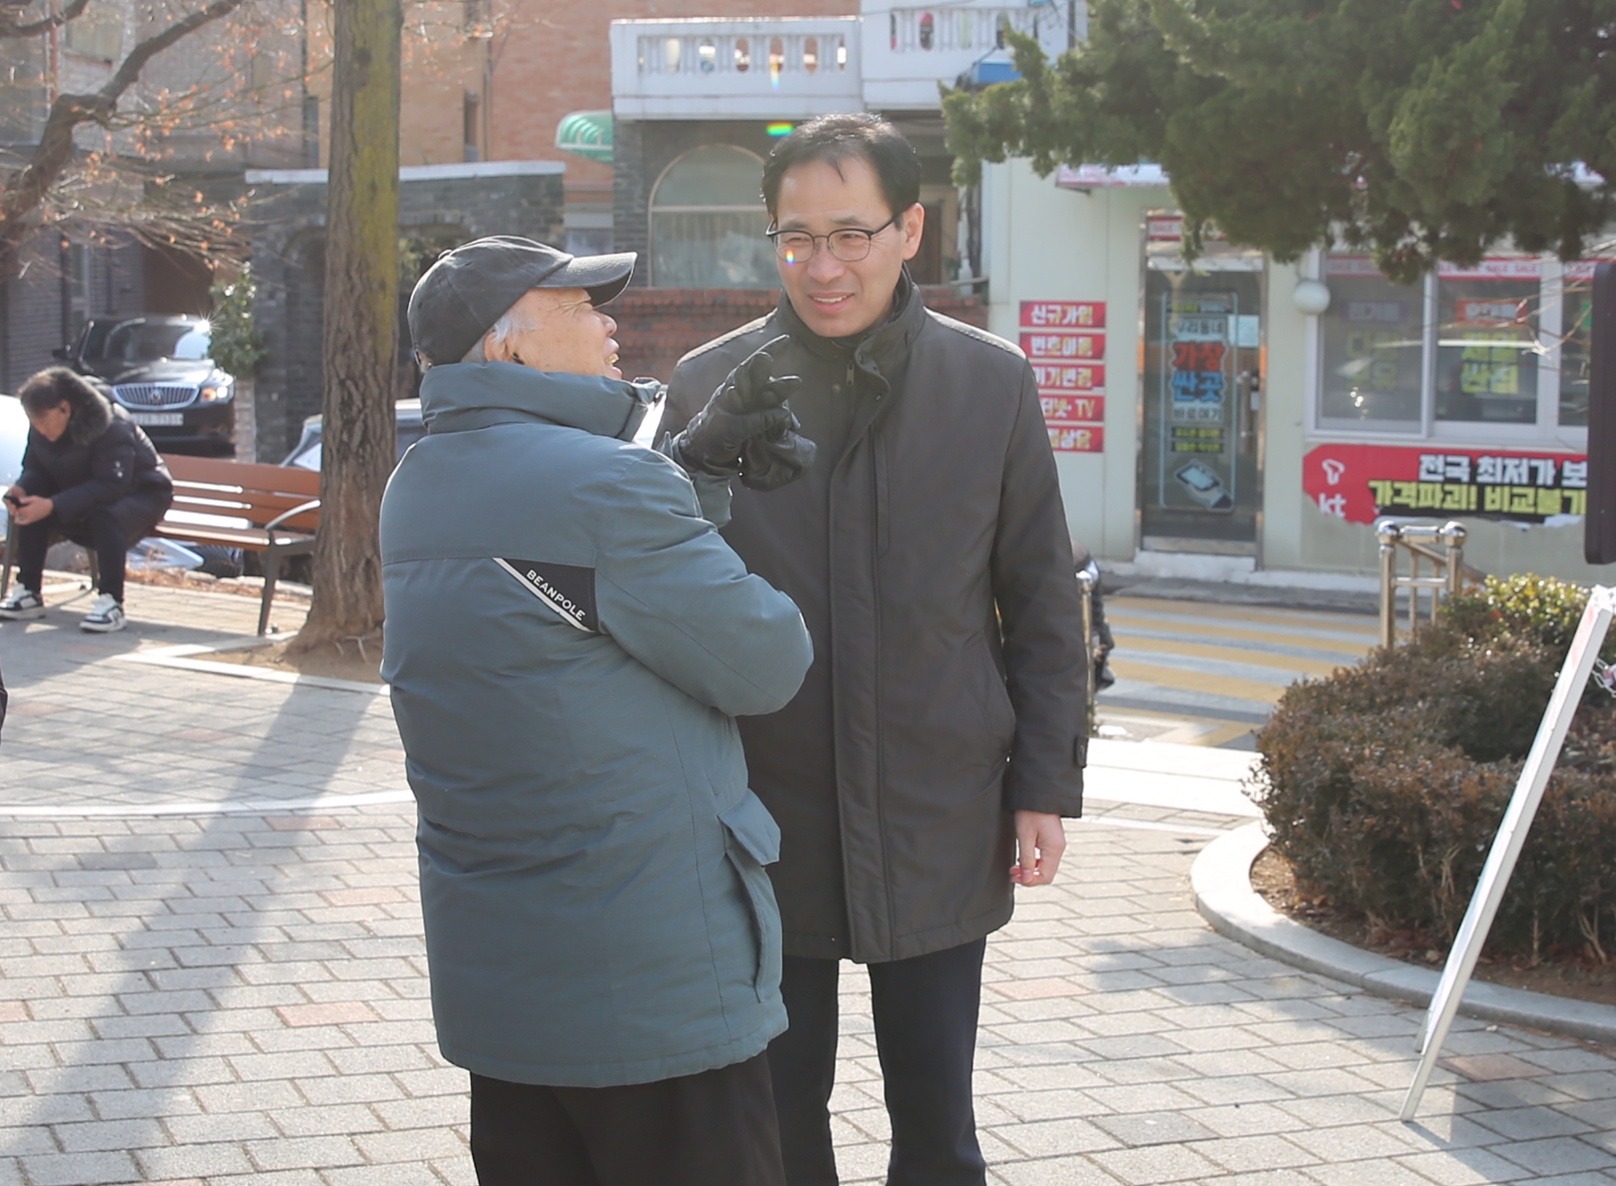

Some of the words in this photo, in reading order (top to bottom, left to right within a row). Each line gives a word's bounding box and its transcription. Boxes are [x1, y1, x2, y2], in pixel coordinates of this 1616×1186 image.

[1031, 304, 1093, 325] 신규가입
[1172, 342, 1225, 371] 가장
[1075, 398, 1096, 419] TV
[1418, 454, 1471, 483] 전국
[1476, 456, 1557, 486] 최저가
[1318, 492, 1347, 518] kt
[1367, 479, 1478, 511] 가격파괴!
[526, 568, 586, 621] BEANPOLE
